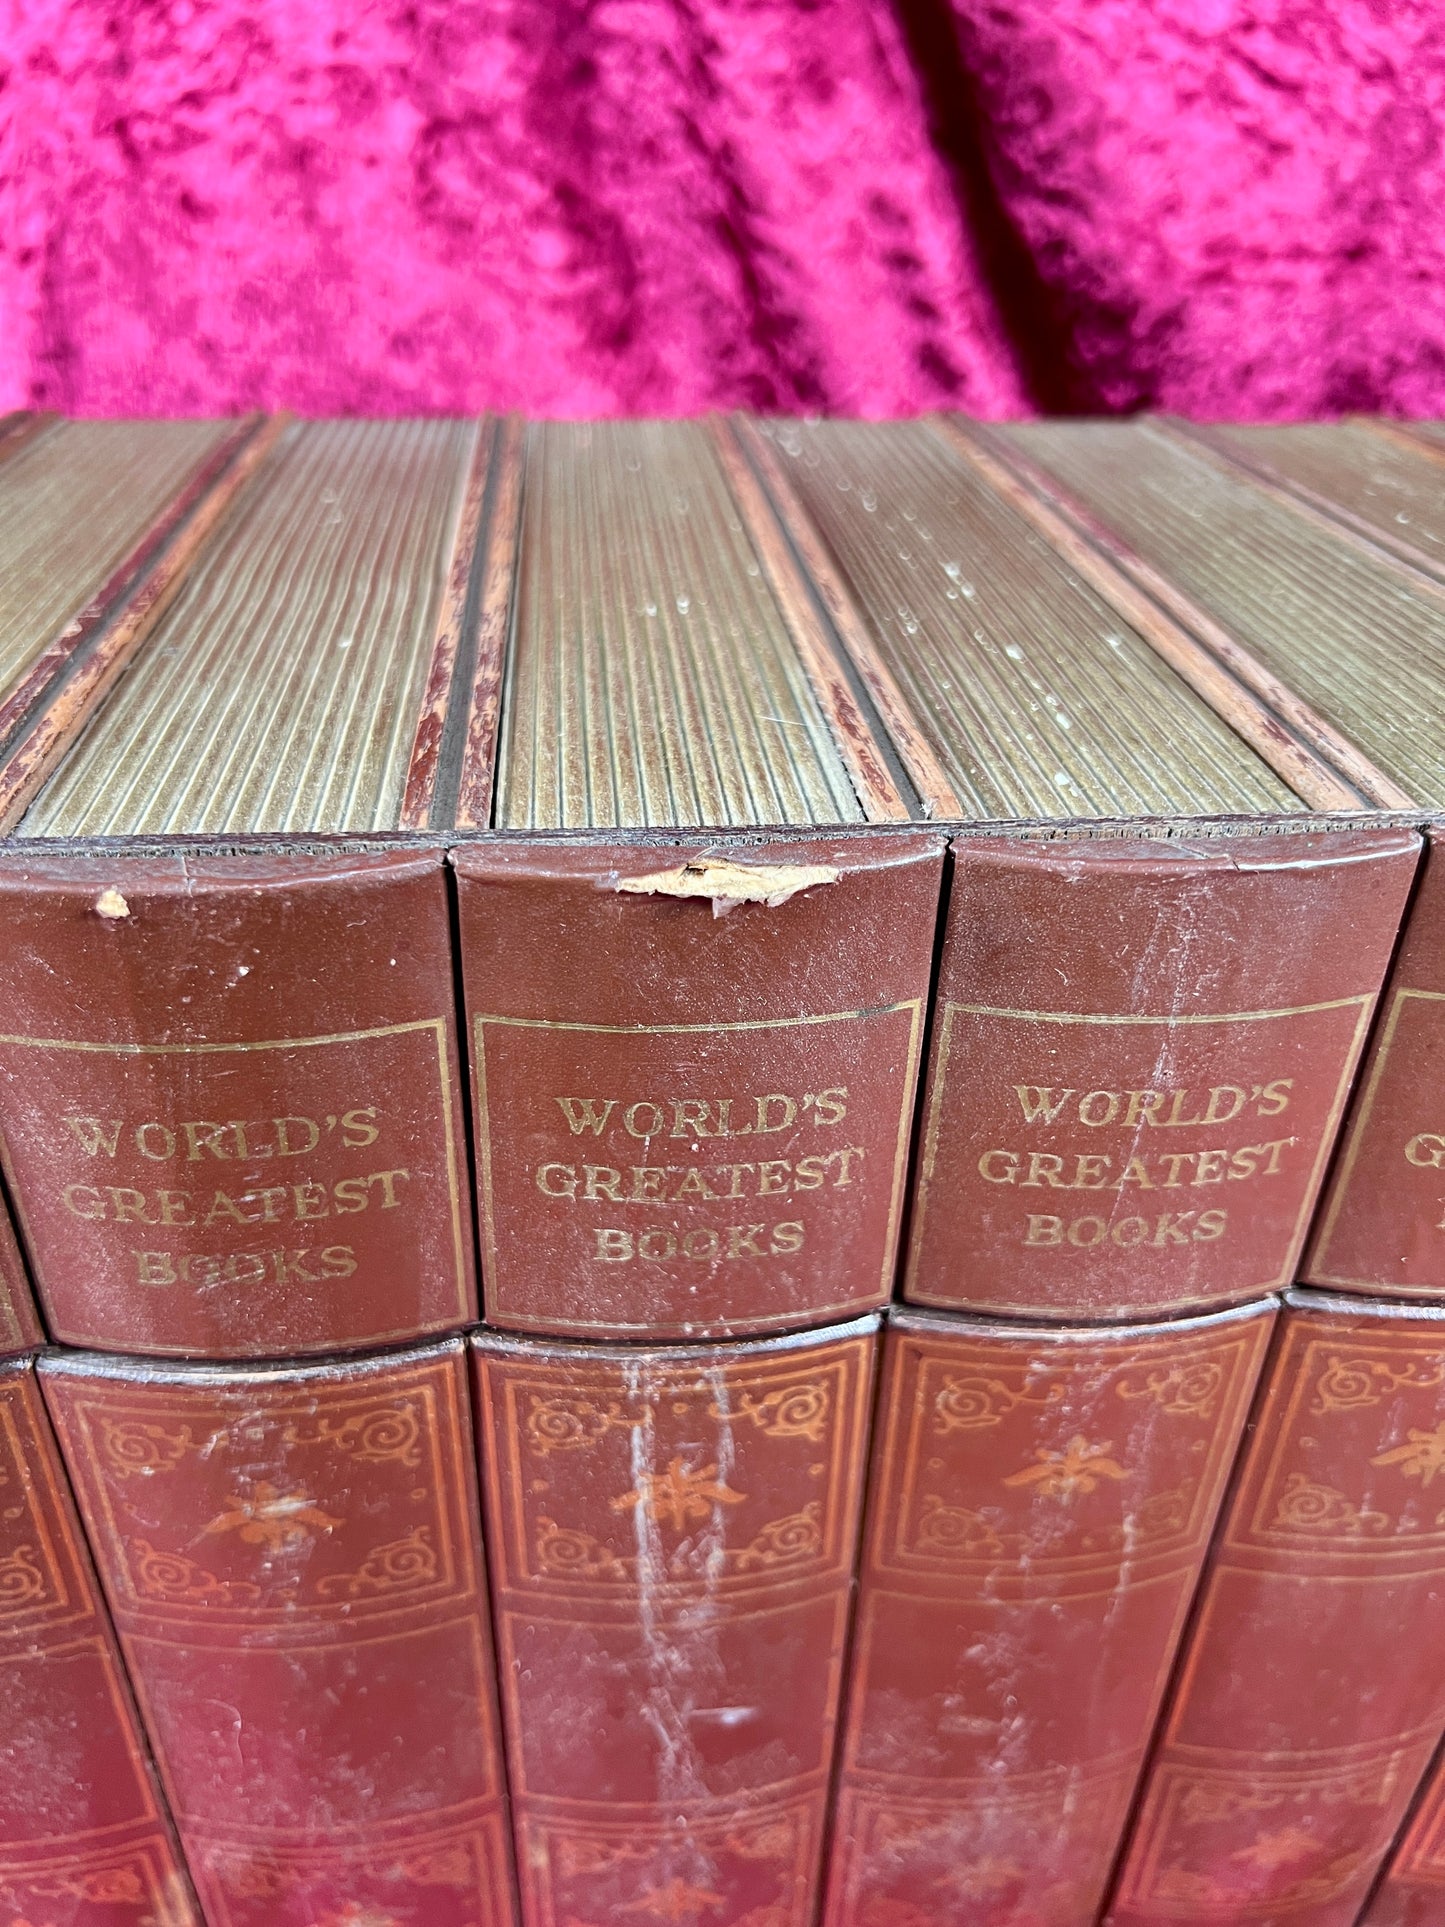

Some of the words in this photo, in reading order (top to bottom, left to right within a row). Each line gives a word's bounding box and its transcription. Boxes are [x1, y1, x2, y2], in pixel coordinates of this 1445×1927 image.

[554, 1087, 849, 1138] WORLD'S
[1011, 1078, 1295, 1127] WORLD'S
[64, 1107, 382, 1161] WORLD'S
[536, 1146, 866, 1202] GREATEST
[977, 1139, 1296, 1189] GREATEST
[63, 1168, 410, 1226] GREATEST
[593, 1220, 806, 1261] BOOKS
[1023, 1208, 1229, 1248] BOOKS
[132, 1246, 358, 1286] BOOKS
